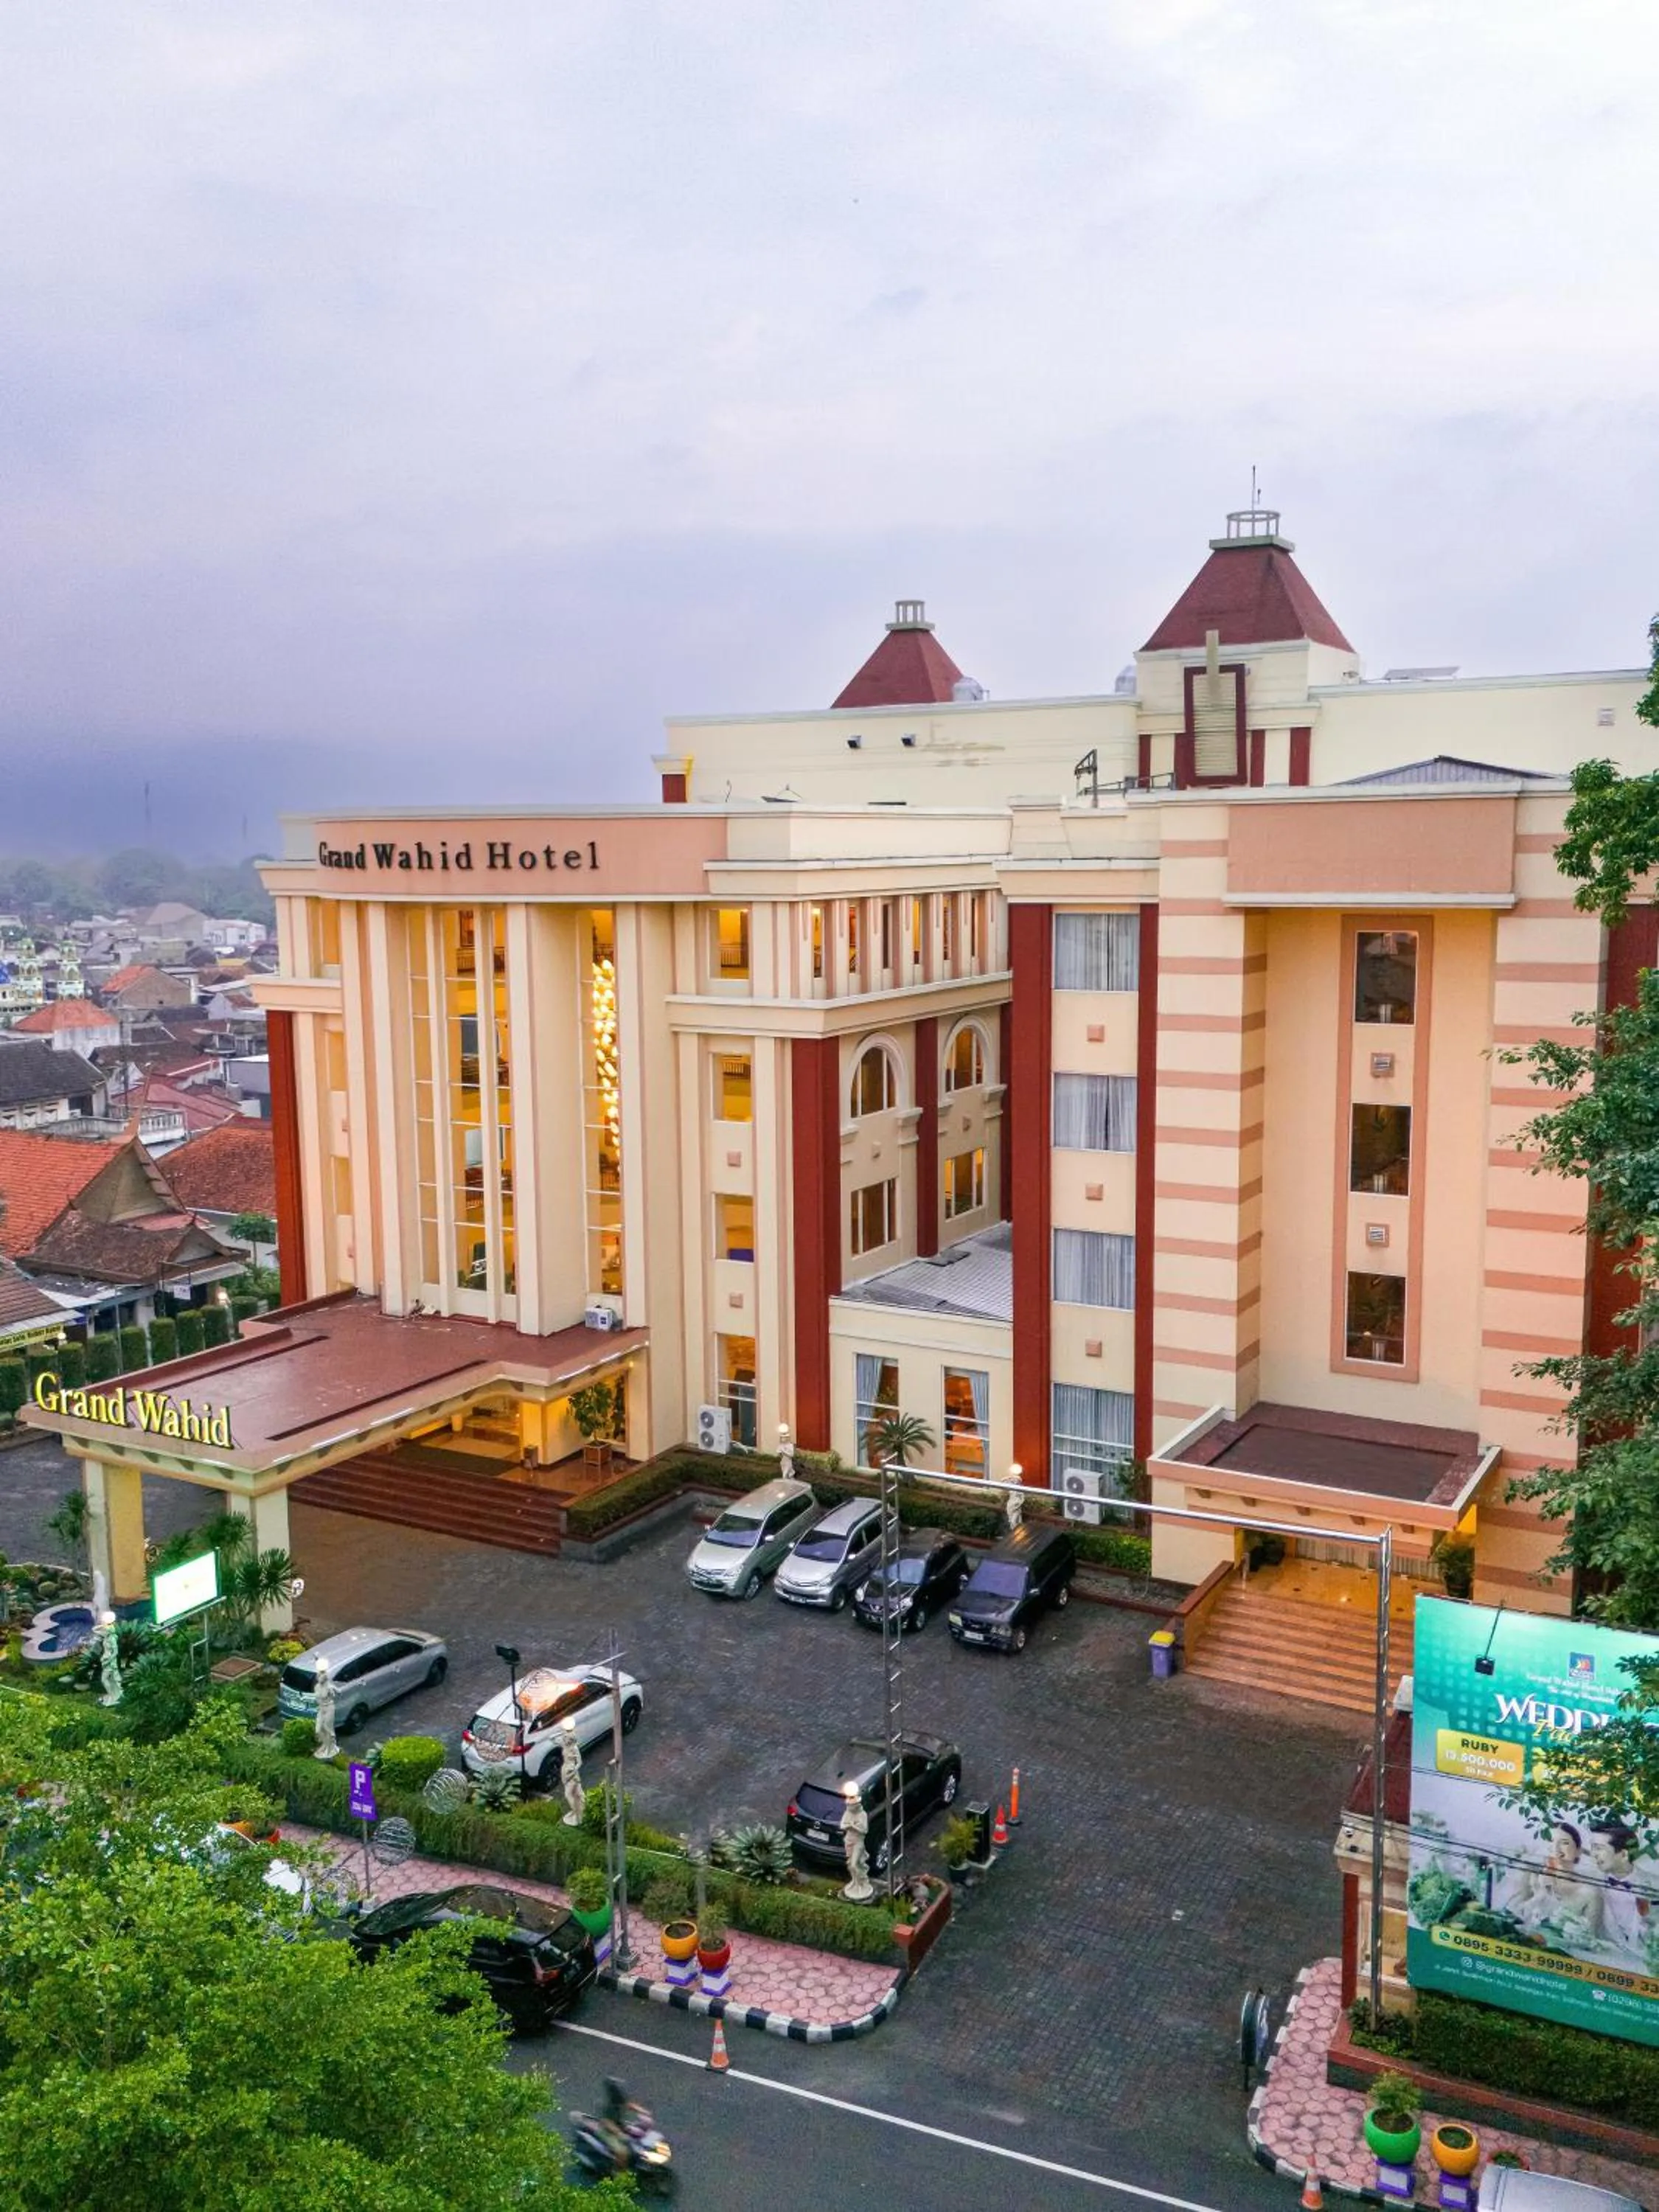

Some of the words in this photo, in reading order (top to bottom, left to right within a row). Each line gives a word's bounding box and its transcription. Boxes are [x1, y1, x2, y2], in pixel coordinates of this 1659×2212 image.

[319, 841, 366, 870] Grand
[372, 841, 474, 870] Wahid
[486, 841, 600, 870] Hotel
[35, 1371, 128, 1427] Grand
[132, 1390, 234, 1449] Wahid
[1461, 1739, 1499, 1754] RUBY
[355, 1770, 366, 1790] P
[1453, 1935, 1489, 1952] 0895
[1495, 1945, 1531, 1962] 3333
